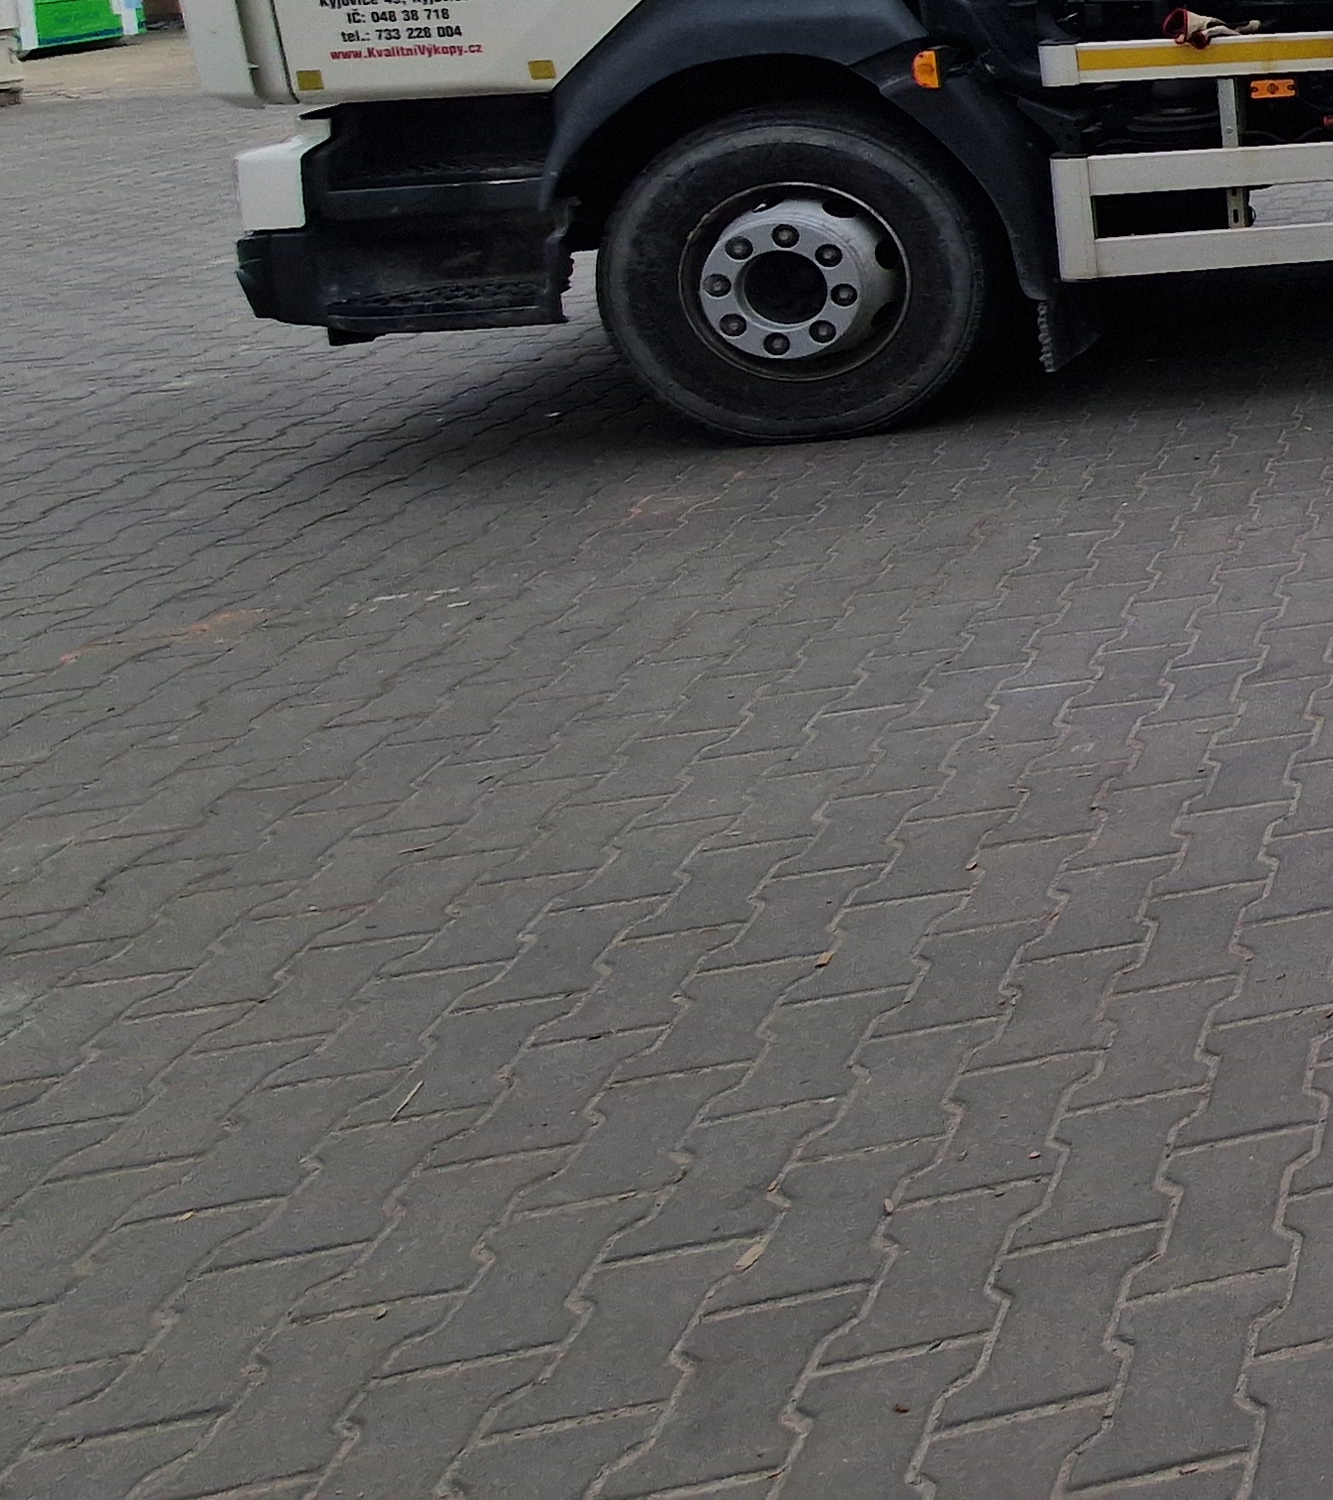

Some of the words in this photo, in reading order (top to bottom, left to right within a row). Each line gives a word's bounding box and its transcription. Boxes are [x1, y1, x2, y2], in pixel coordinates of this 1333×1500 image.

[346, 8, 366, 24] IČ:
[371, 11, 397, 23] 048
[401, 10, 419, 21] 38
[423, 8, 450, 20] 718
[375, 29, 401, 41] 733
[405, 27, 432, 39] 228
[437, 25, 463, 37] 004
